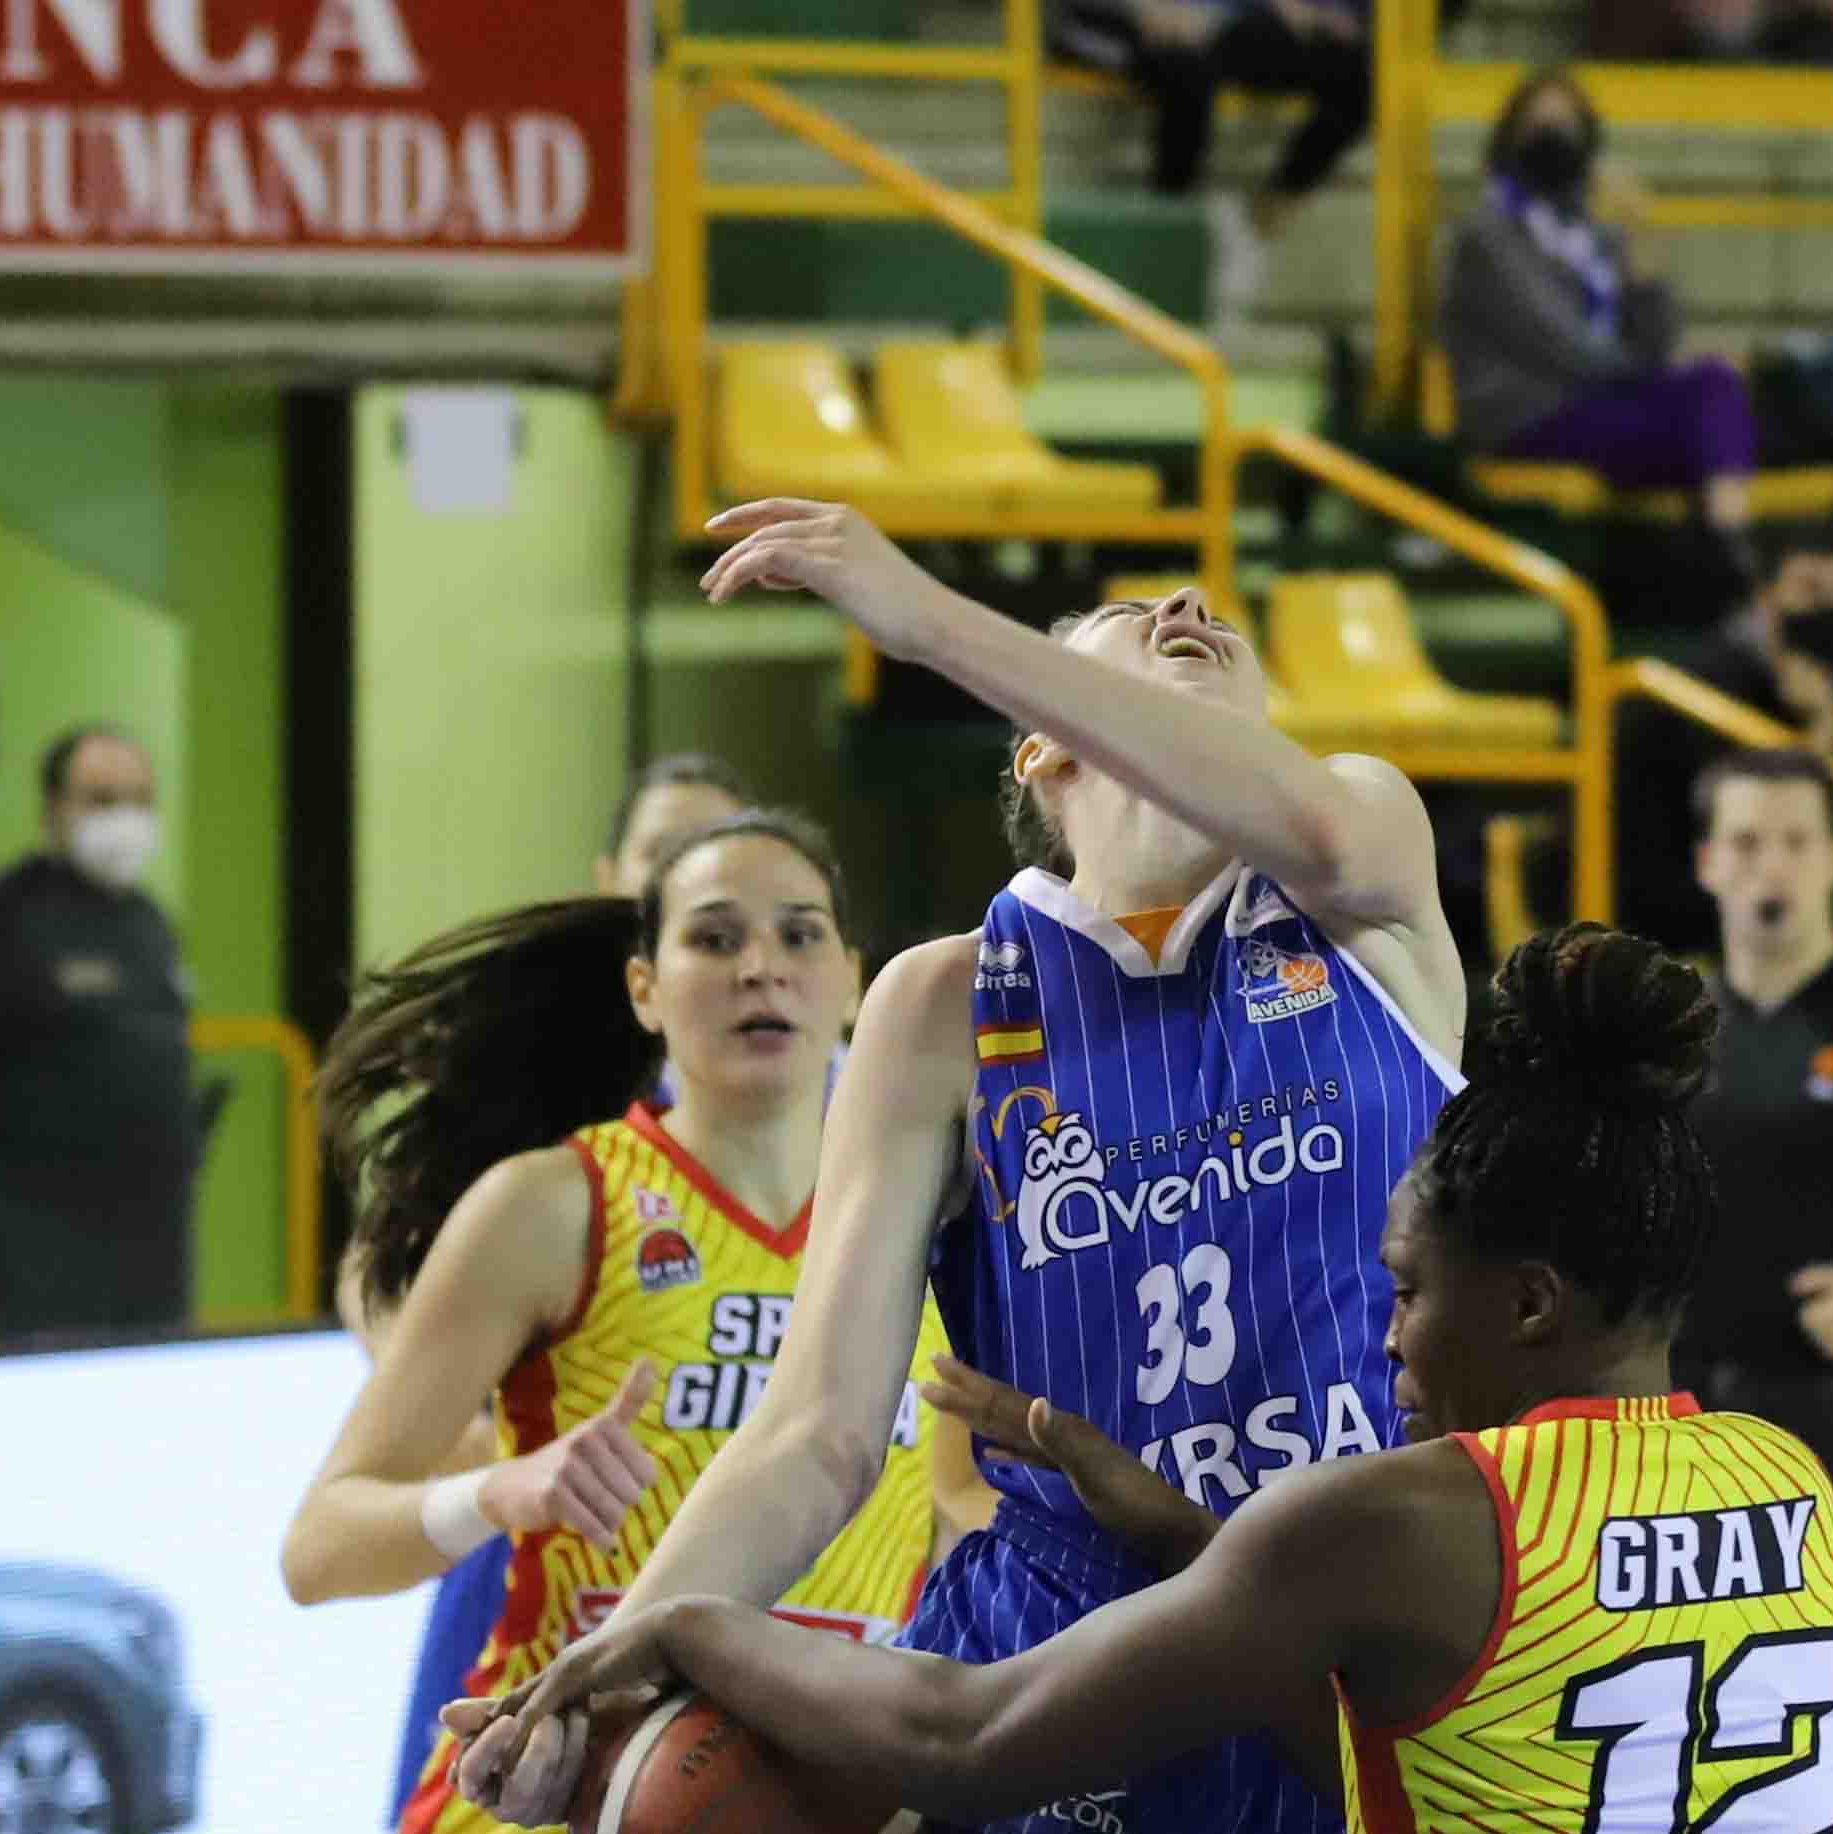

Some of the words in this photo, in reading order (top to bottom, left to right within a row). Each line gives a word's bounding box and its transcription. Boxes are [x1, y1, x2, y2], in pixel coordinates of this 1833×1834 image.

[1248, 983, 1334, 1020] AVENIDA
[708, 1292, 796, 1360] SP
[1134, 1243, 1238, 1406] 33
[1140, 1381, 1384, 1507] RSA
[1594, 1496, 1818, 1612] GRAY
